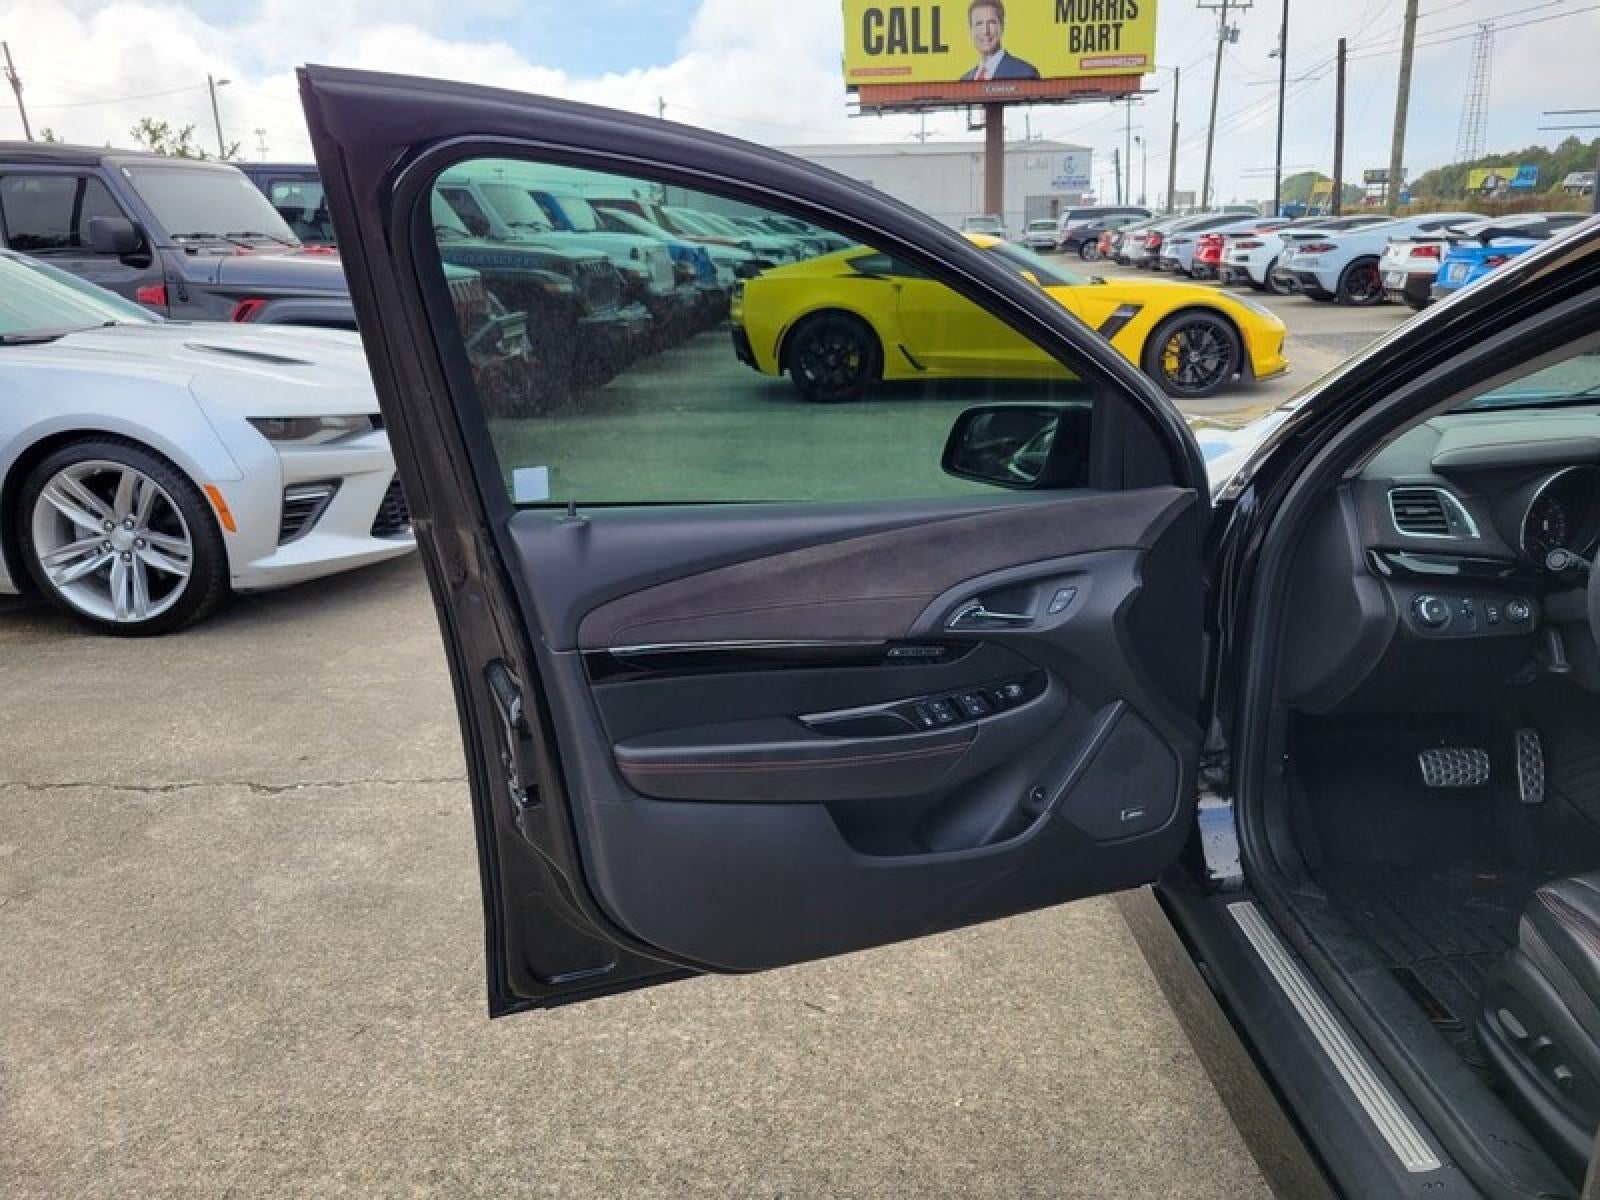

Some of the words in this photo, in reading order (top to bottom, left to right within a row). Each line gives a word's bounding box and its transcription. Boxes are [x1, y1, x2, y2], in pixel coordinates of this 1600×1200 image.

[1056, 0, 1138, 23] MORRIS
[863, 6, 949, 55] CALL
[1069, 22, 1123, 53] BART
